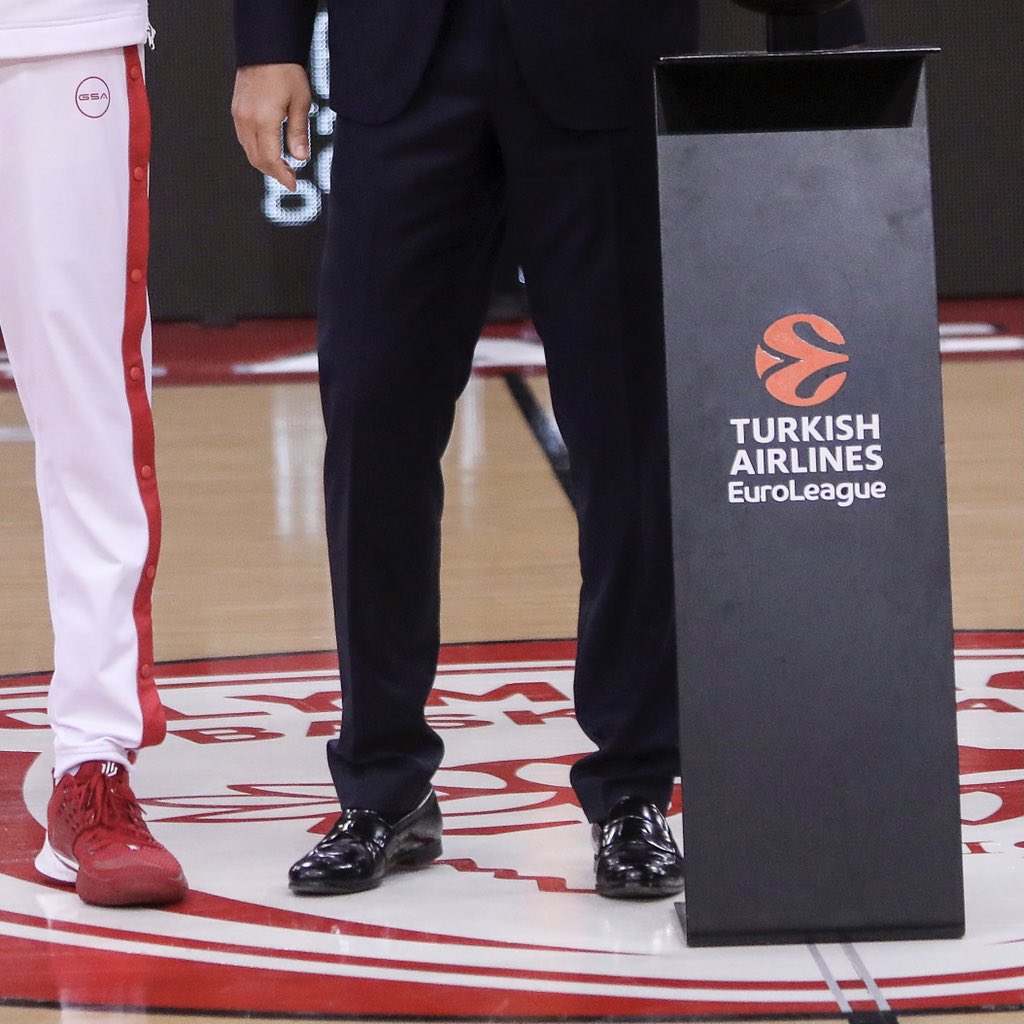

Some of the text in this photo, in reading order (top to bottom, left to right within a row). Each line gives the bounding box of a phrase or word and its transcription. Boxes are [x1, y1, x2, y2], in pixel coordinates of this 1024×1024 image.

[730, 414, 880, 444] TURKISH
[730, 444, 884, 475] AIRLINES
[728, 479, 887, 507] EuroLeague
